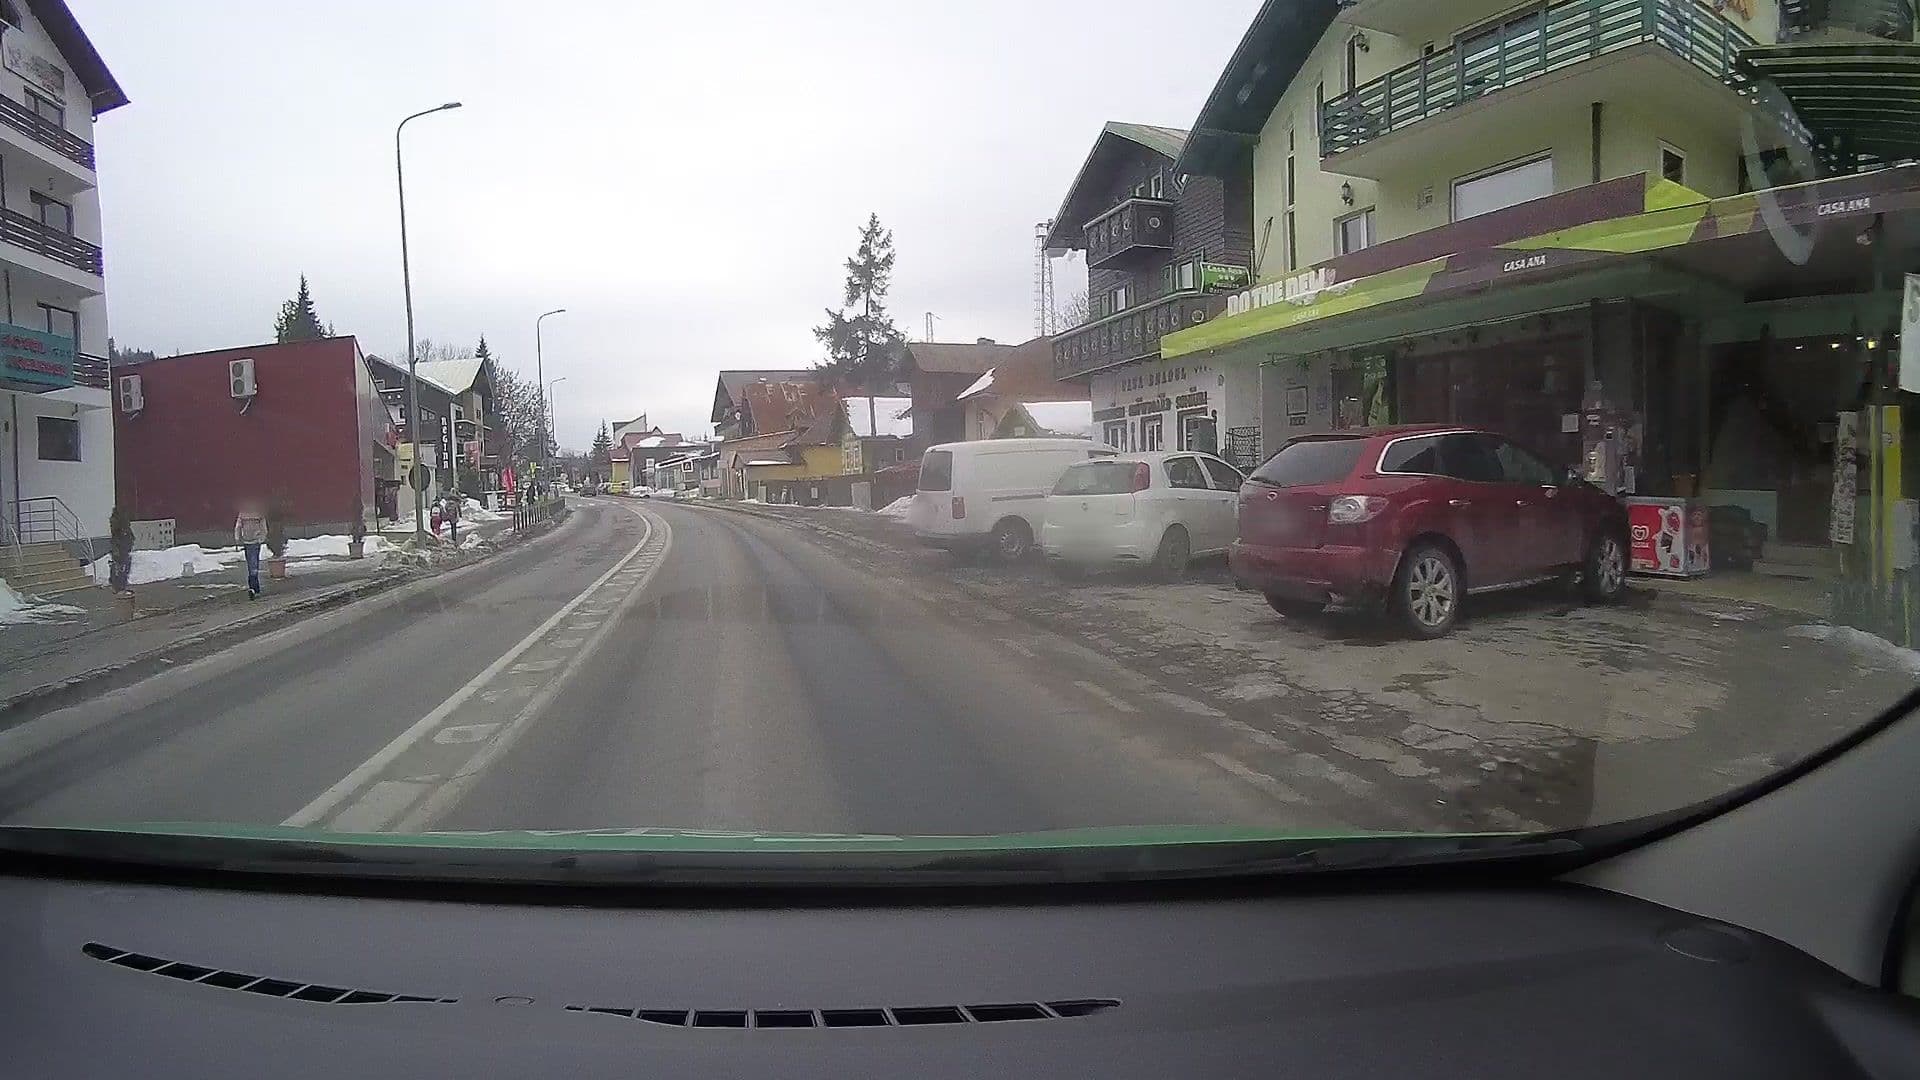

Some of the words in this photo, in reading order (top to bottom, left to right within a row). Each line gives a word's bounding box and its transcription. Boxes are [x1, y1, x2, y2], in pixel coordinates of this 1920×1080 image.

[1818, 201, 1846, 216] CASA
[1847, 198, 1871, 212] ANA
[1503, 259, 1526, 272] CASA
[1526, 255, 1547, 269] ANA
[1251, 281, 1284, 310] THE
